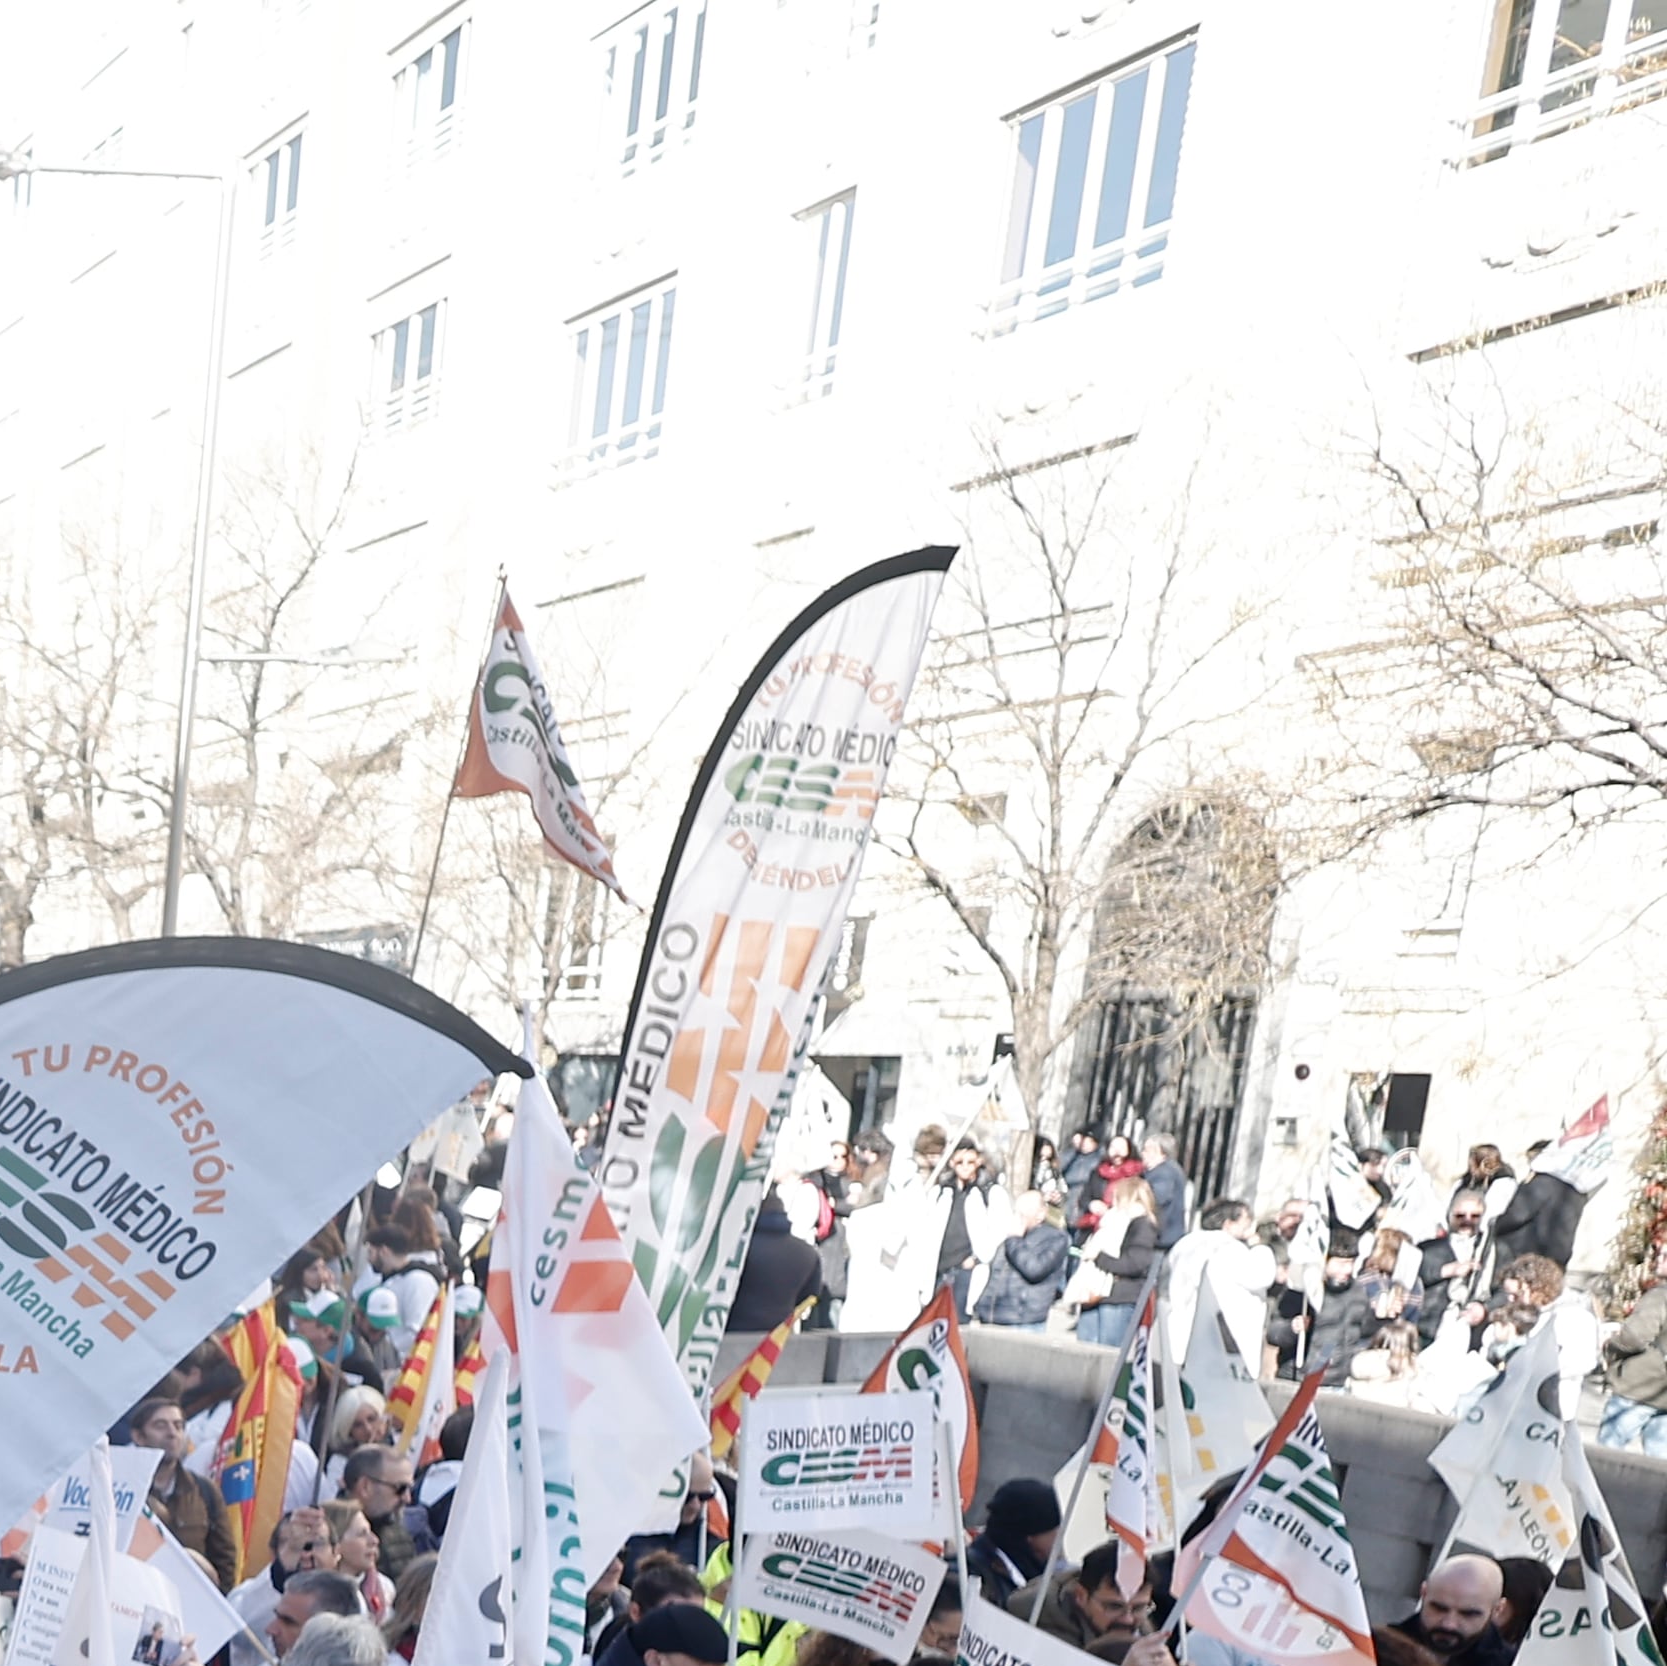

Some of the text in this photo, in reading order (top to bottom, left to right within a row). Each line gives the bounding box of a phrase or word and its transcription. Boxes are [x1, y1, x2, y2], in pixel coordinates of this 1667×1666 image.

[617, 920, 698, 1139] MÉDICO
[12, 1044, 235, 1216] TU PROFESIÓN
[93, 1171, 217, 1281] MÉDICO
[0, 1269, 95, 1359] Mancha
[760, 1446, 913, 1488] CESM
[767, 1416, 915, 1450] SINDICATO MÉDICO
[772, 1494, 845, 1512] Castilla-La
[847, 1489, 904, 1507] Mancha
[762, 1552, 919, 1624] CESM
[774, 1530, 927, 1594] SINDICATO MÉDICO
[763, 1583, 897, 1639] Castilla-La Mancha
